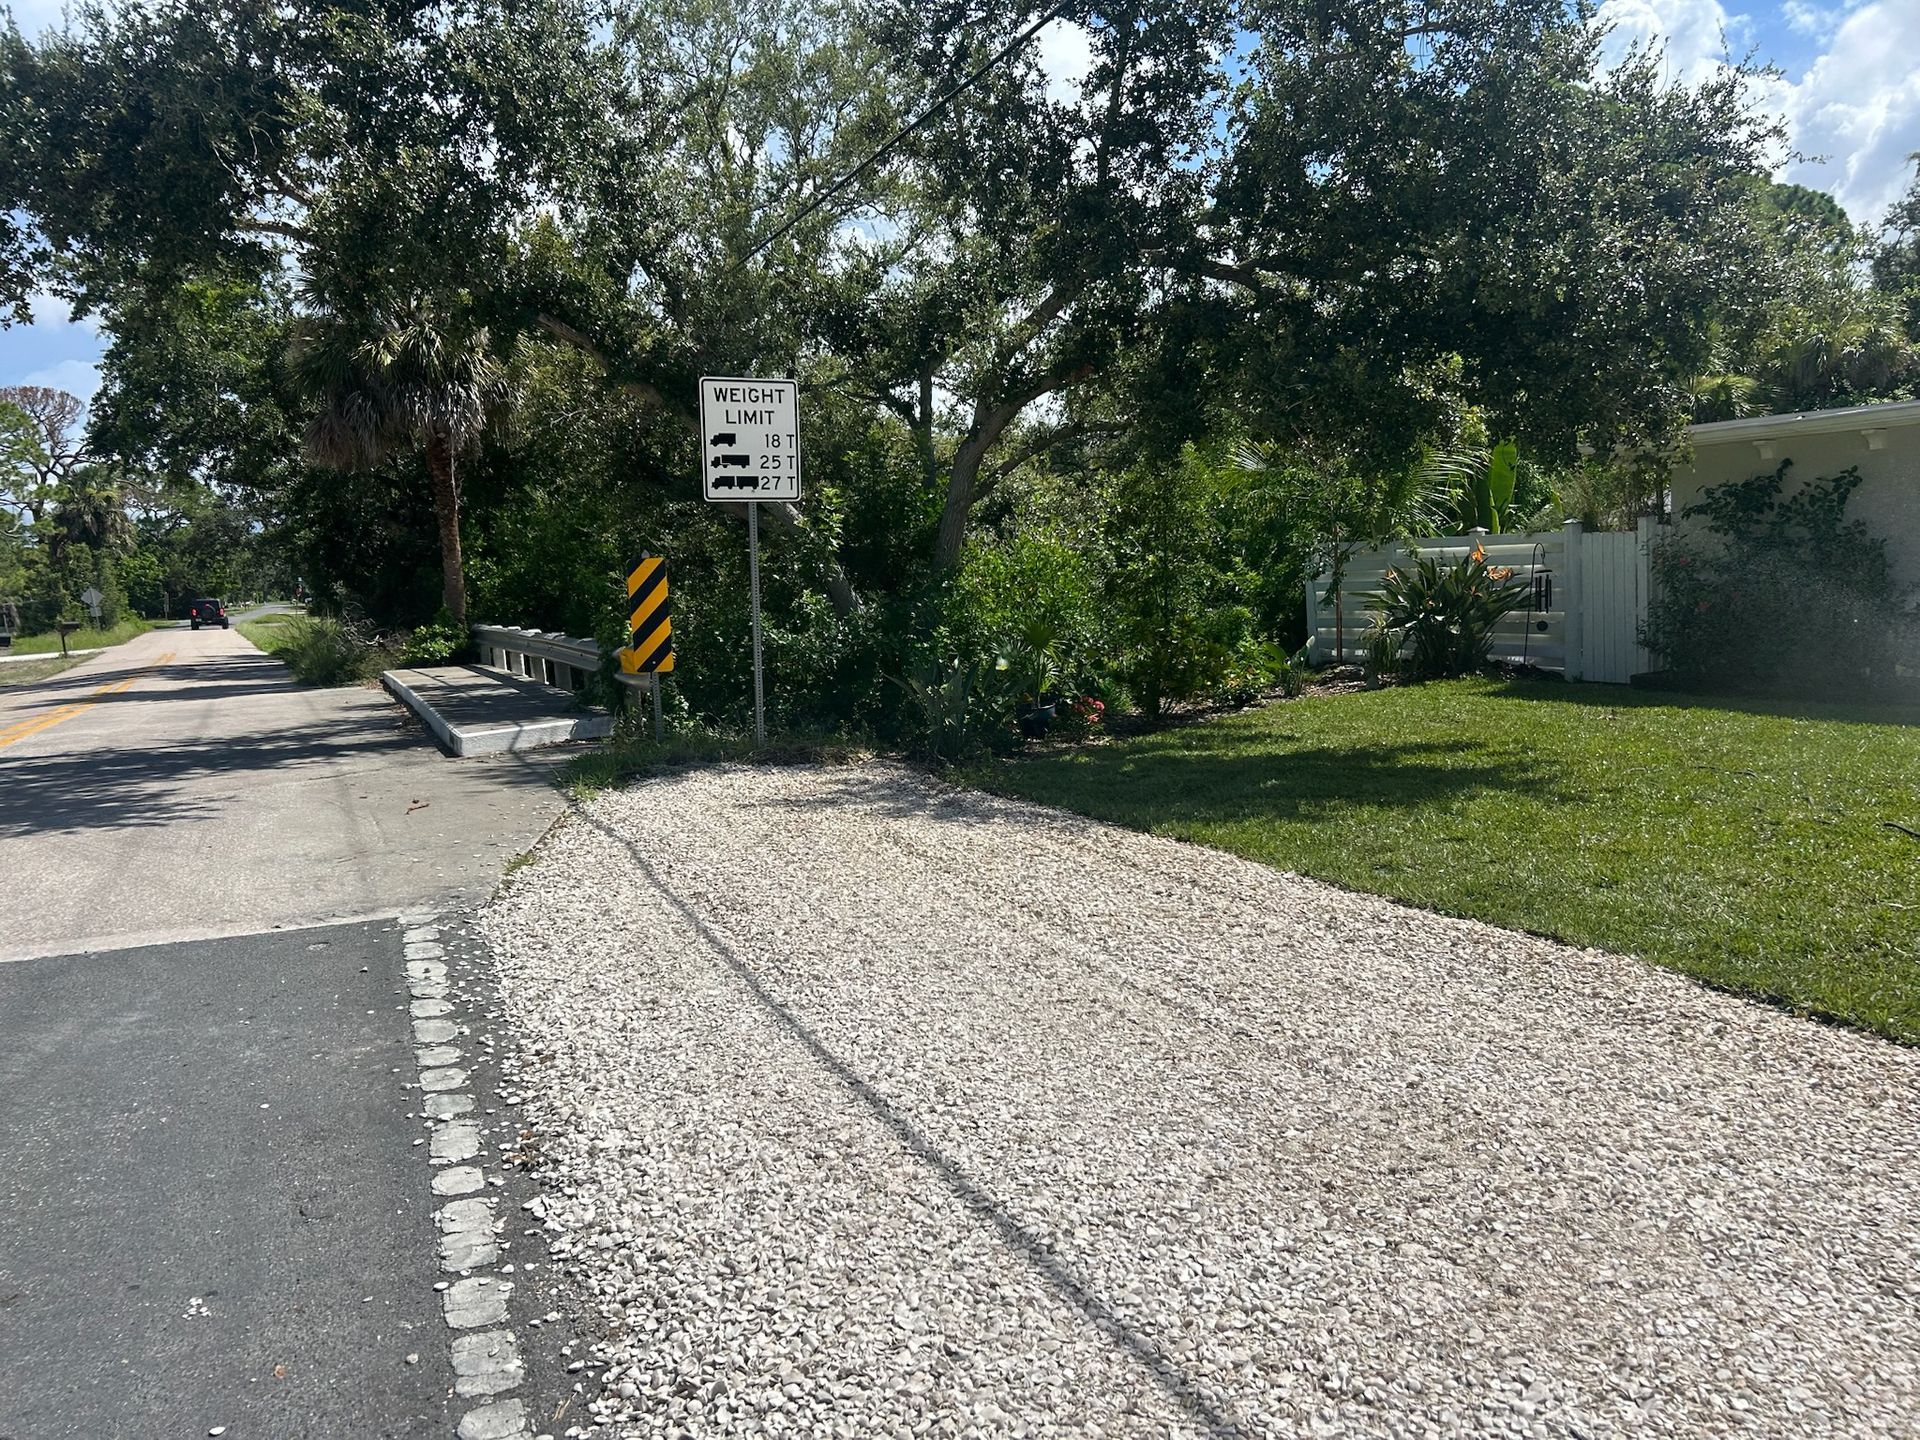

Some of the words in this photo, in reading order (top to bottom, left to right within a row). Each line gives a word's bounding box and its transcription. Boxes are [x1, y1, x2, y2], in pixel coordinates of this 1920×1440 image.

[713, 387, 785, 404] WEIGHT
[725, 409, 775, 425] LIMIT
[765, 433, 781, 448] 18
[786, 434, 795, 449] T
[760, 455, 781, 469] 25
[787, 455, 795, 470] T
[761, 476, 781, 490] 27
[787, 476, 796, 491] T
